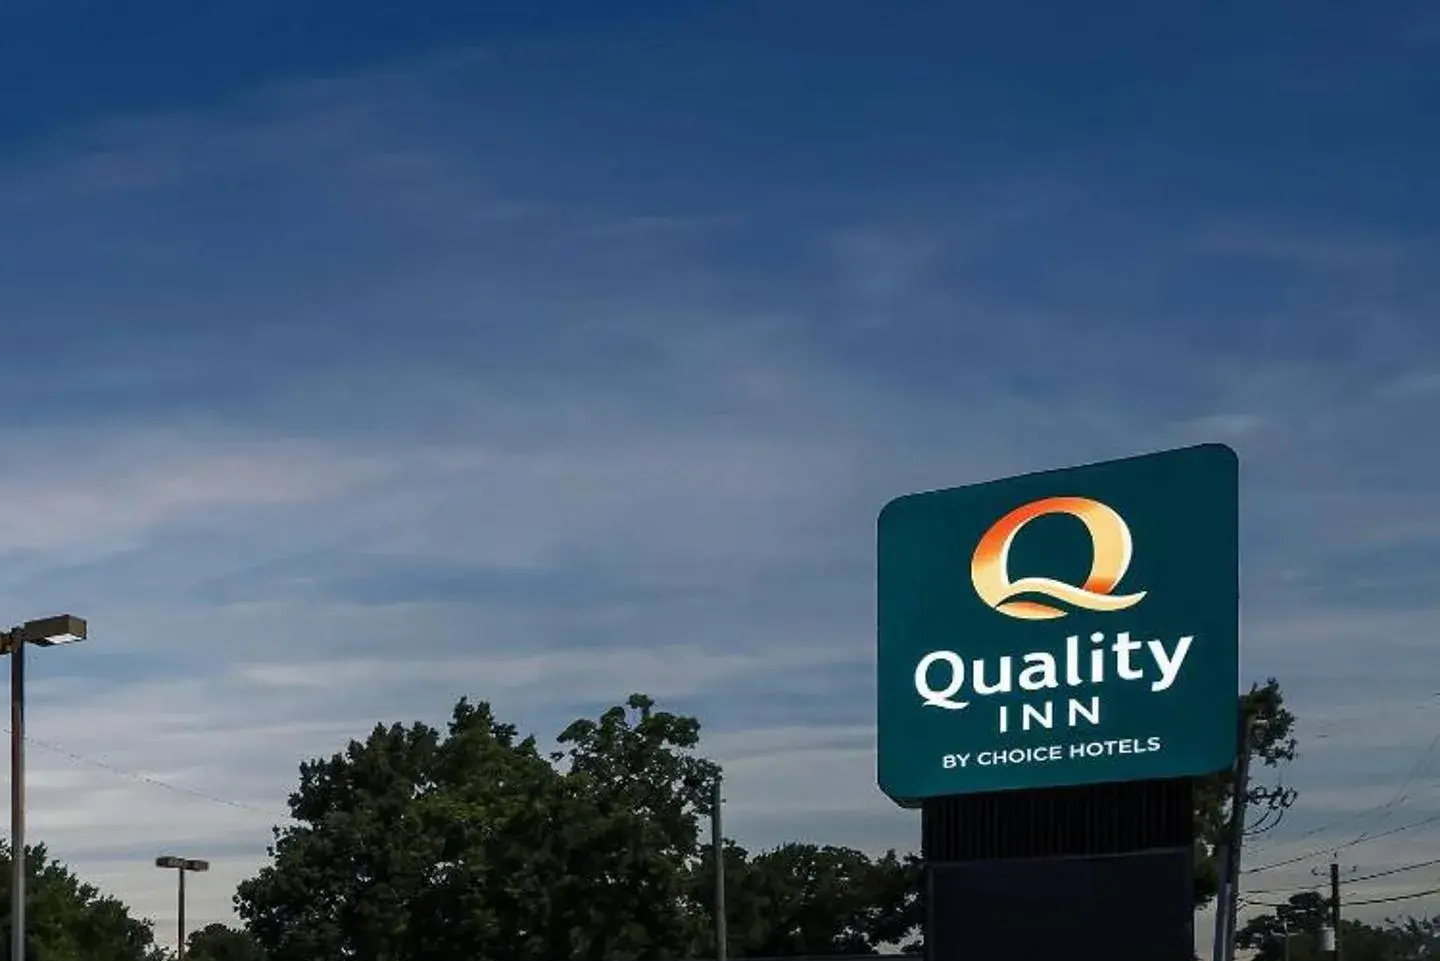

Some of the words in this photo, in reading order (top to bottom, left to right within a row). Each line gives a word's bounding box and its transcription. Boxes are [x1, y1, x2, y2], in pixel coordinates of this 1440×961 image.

[971, 496, 1148, 620] Q
[914, 631, 1195, 710] Quality
[999, 696, 1101, 734] INN
[942, 753, 971, 769] BY
[977, 745, 1063, 765] CHOICE
[1069, 736, 1162, 759] HOTELS
